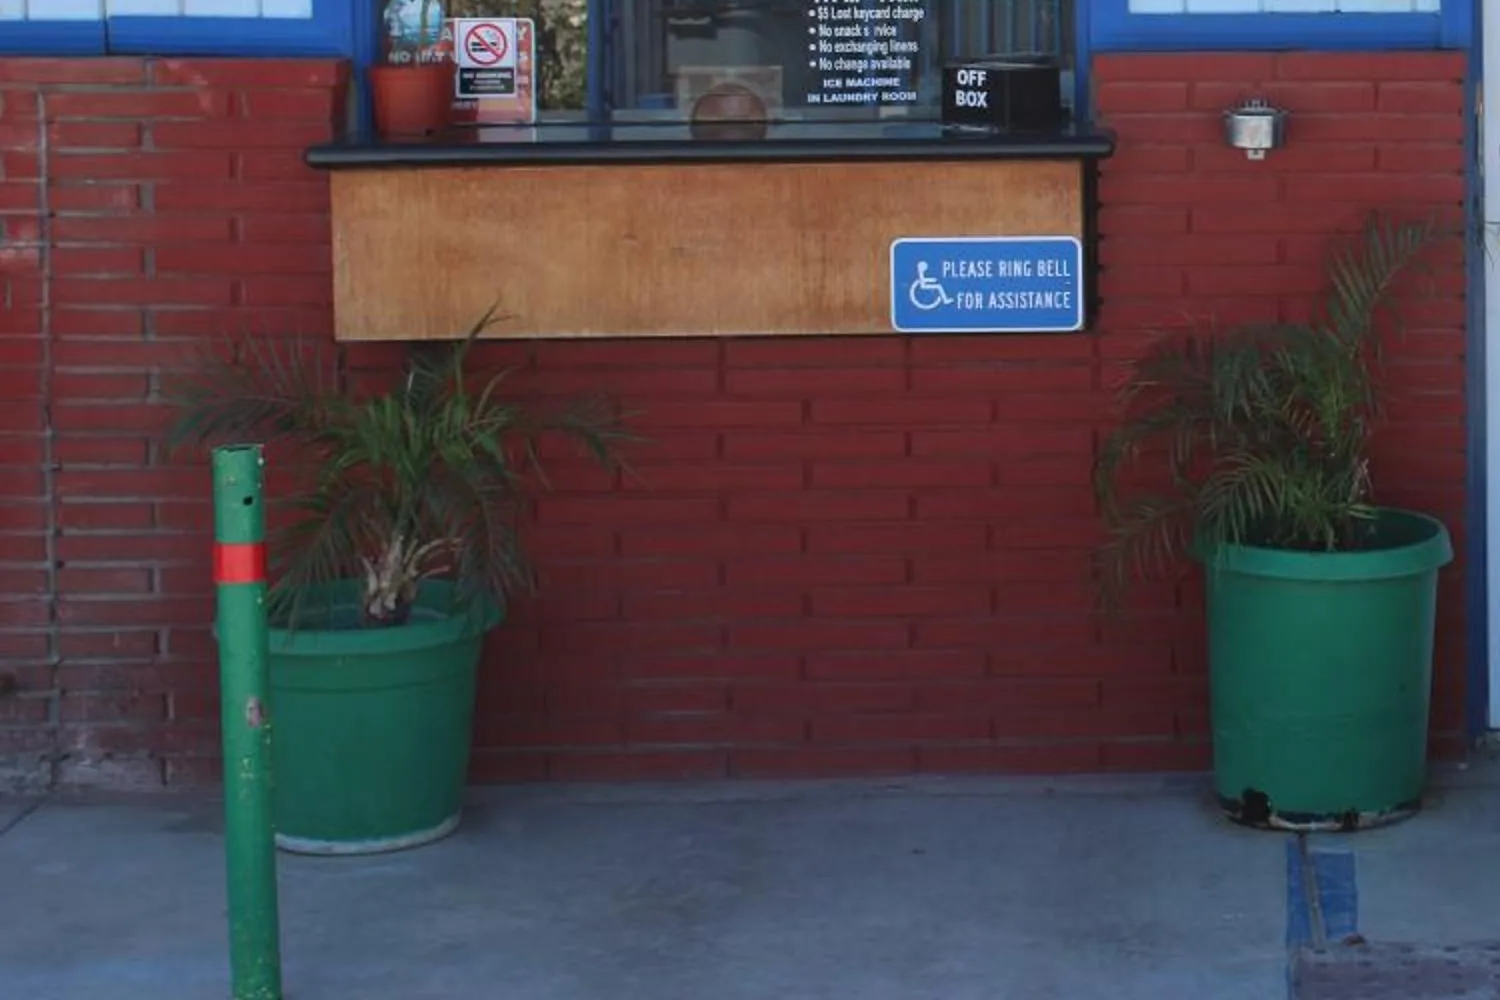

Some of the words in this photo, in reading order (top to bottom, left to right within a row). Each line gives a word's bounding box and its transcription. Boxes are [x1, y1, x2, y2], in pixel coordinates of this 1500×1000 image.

[892, 6, 924, 22] charge
[818, 24, 833, 37] No
[819, 39, 832, 53] No
[819, 57, 832, 70] No
[956, 69, 987, 85] OFF
[955, 90, 988, 107] BOX
[943, 260, 993, 278] PLEASE
[999, 260, 1032, 278] RING
[1037, 259, 1071, 277] BELL
[957, 291, 983, 309] FOR
[988, 291, 1071, 309] ASSISTANCE
